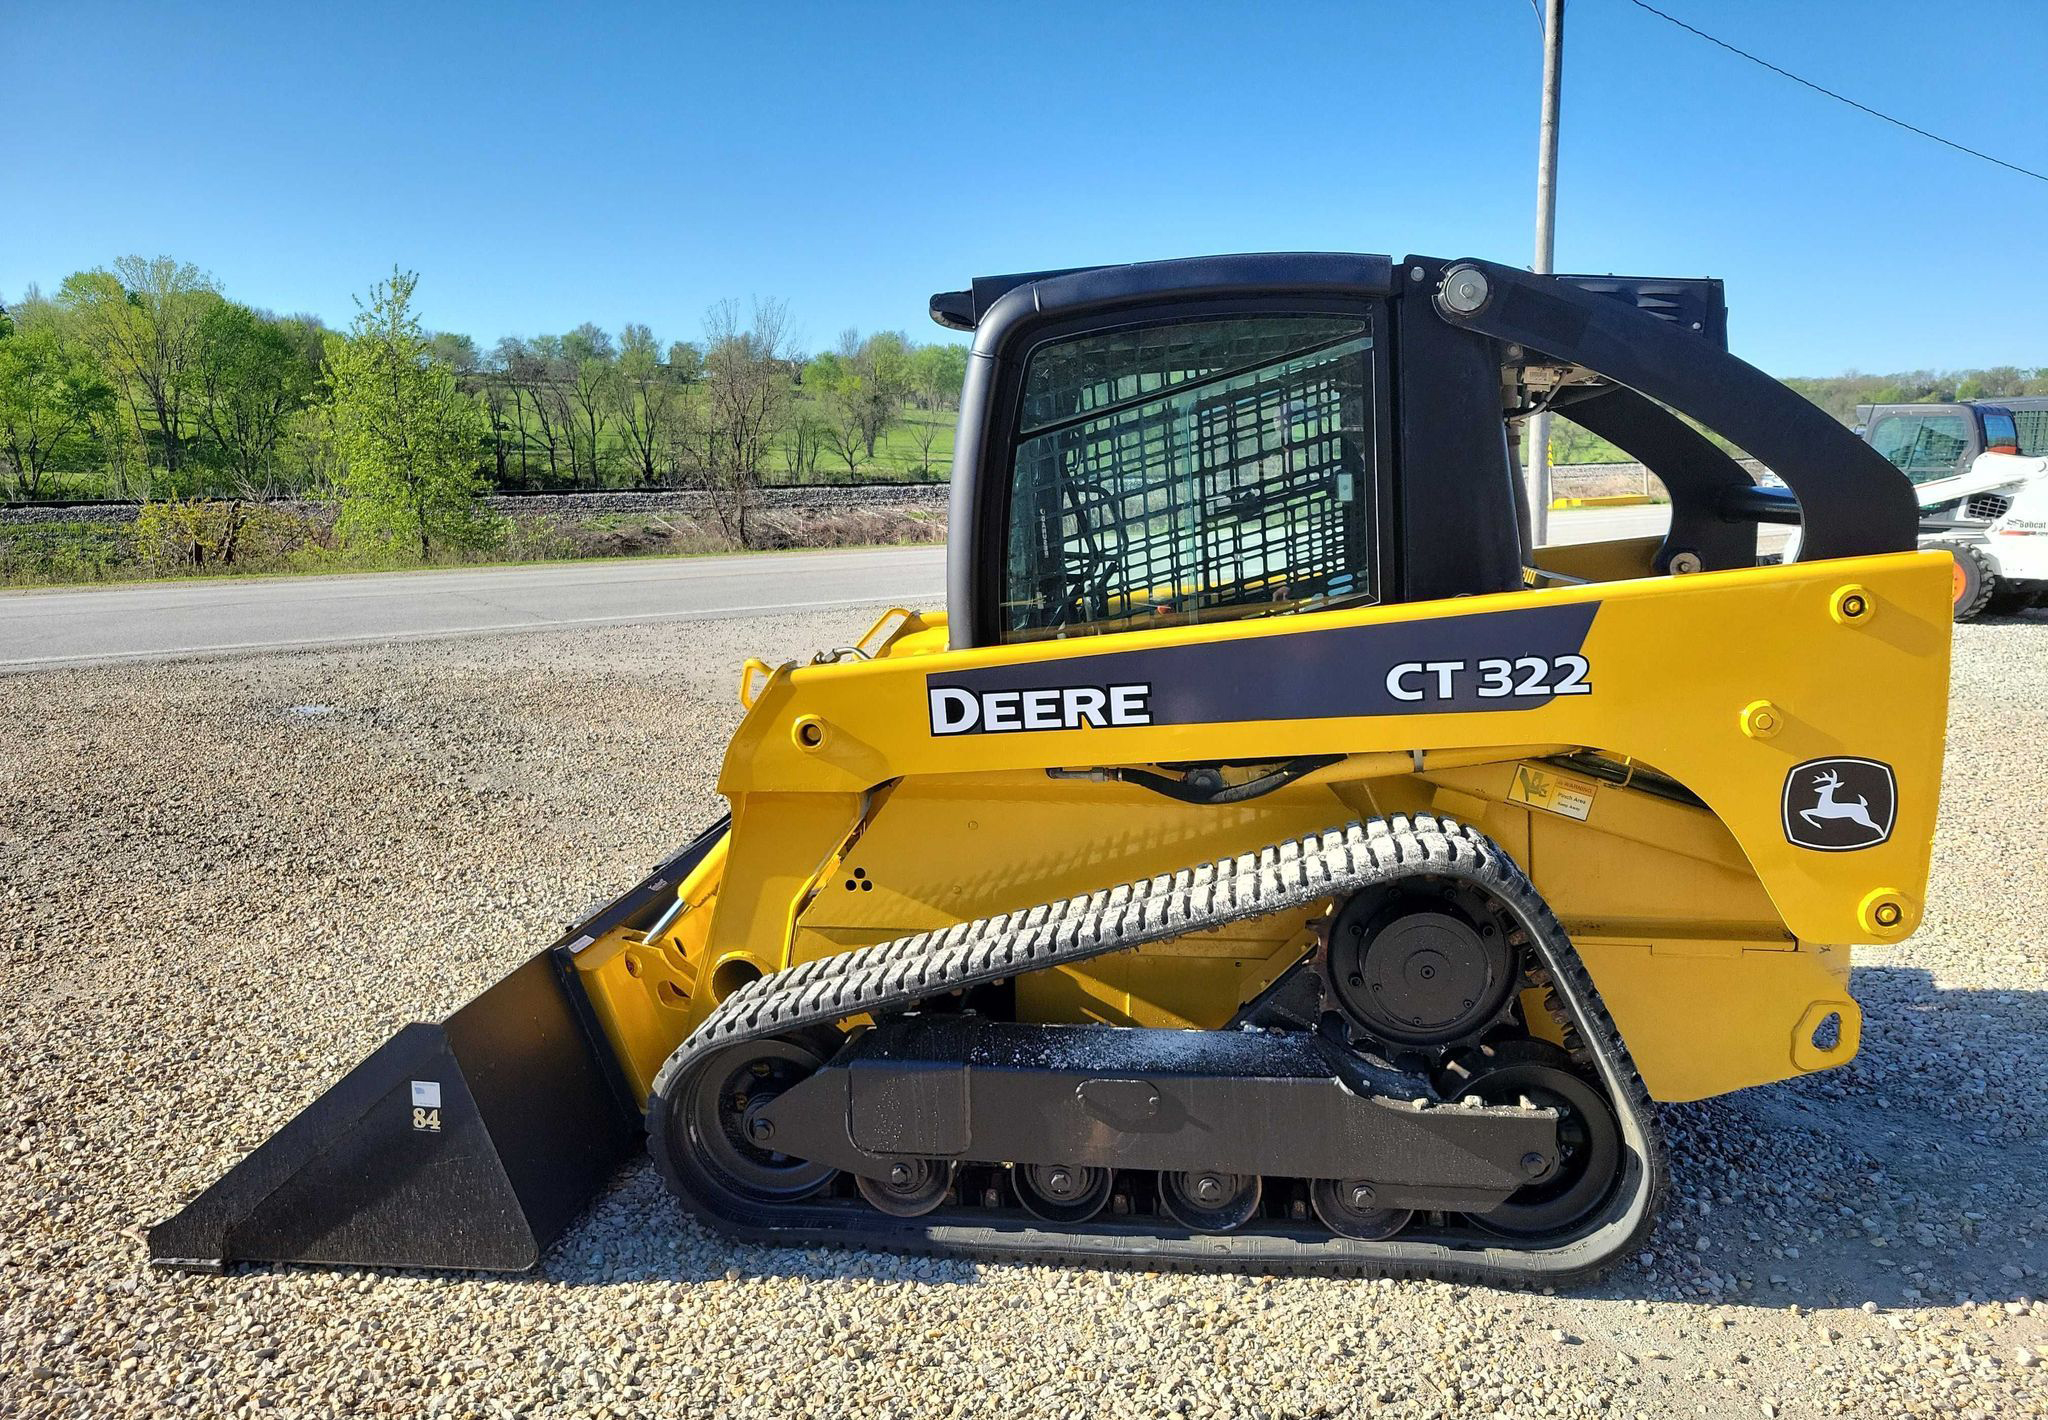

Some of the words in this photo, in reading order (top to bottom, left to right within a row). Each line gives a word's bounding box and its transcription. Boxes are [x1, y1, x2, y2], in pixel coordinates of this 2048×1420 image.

[1385, 661, 1465, 701] CT
[1477, 654, 1591, 698] 322
[929, 684, 1151, 735] DEERE
[1558, 792, 1573, 801] Pinch
[1573, 797, 1586, 805] Area
[1564, 783, 1592, 794] WARNING
[413, 1108, 441, 1129] 84
